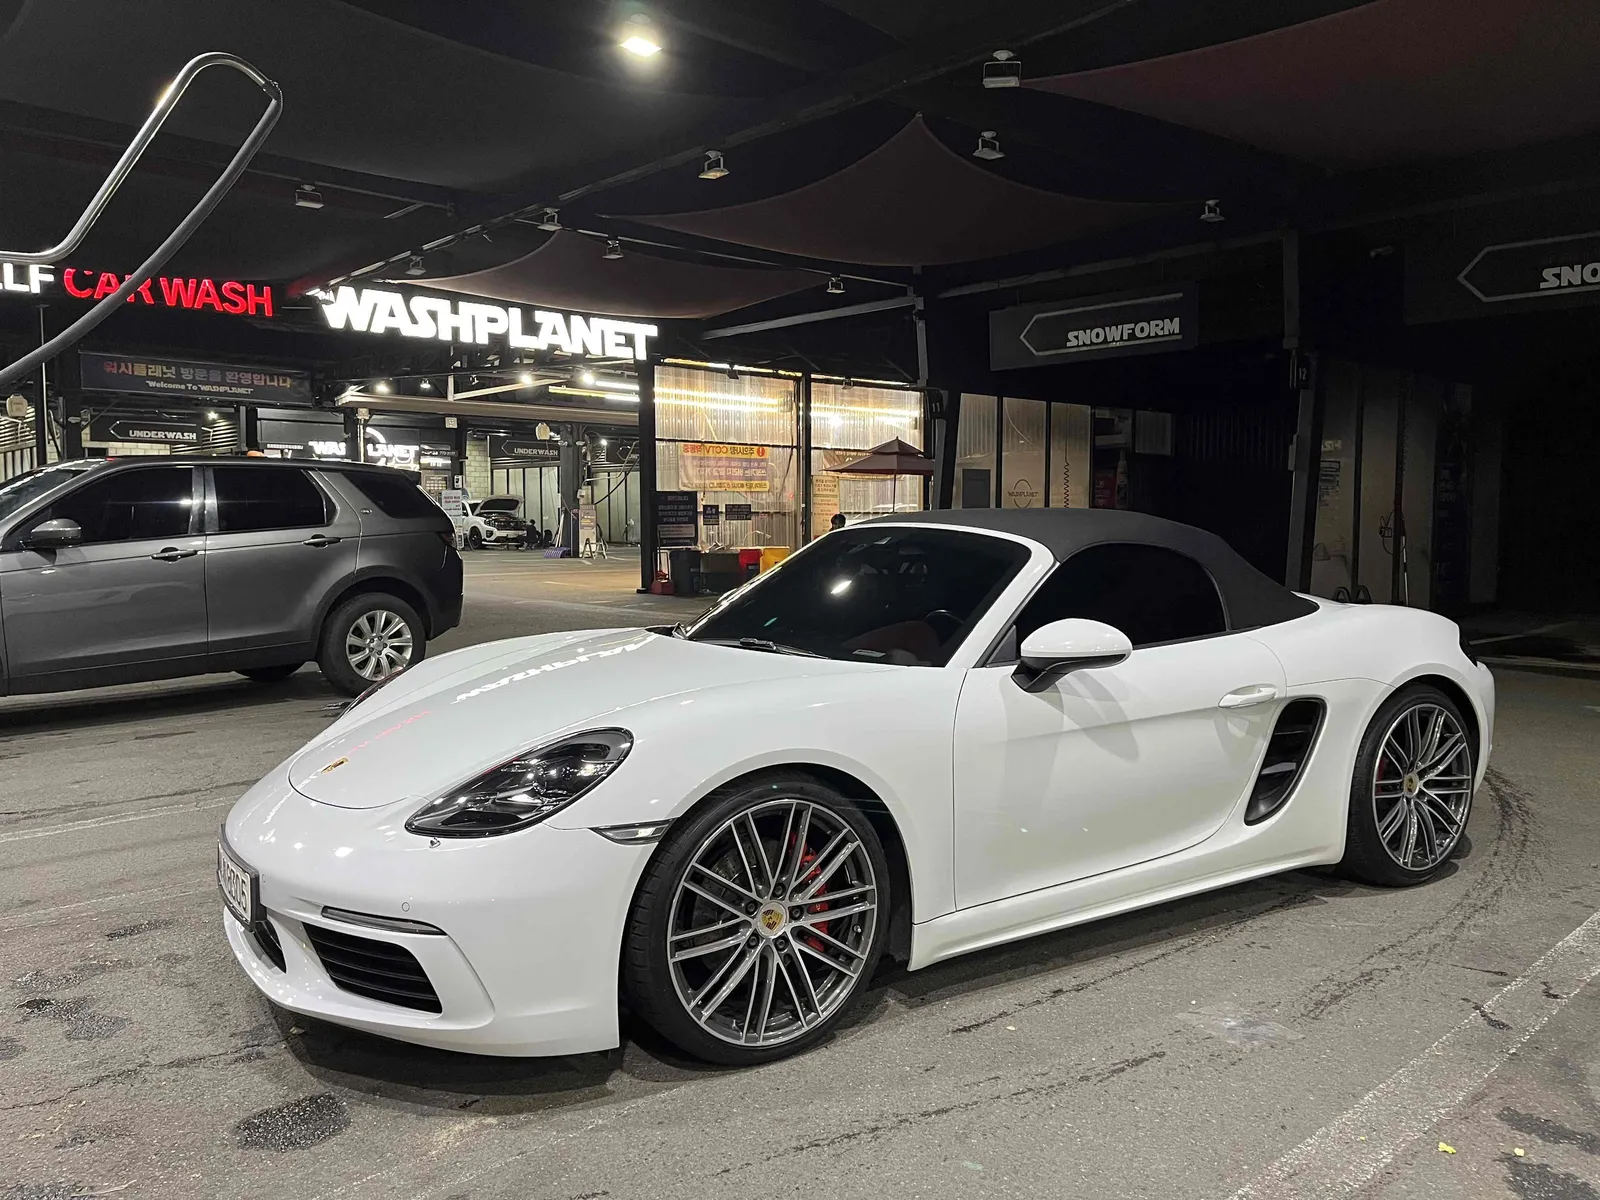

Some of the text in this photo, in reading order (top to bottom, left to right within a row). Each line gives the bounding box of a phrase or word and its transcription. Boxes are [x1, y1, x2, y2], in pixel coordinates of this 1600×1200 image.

[0, 262, 54, 294] LF
[159, 277, 274, 317] WASH
[321, 285, 659, 360] WASHPLANET
[1066, 317, 1180, 347] SNOWFORM
[146, 380, 254, 395] Welcome To WASHPLANET
[179, 366, 222, 383] 방문을
[225, 370, 292, 388] 환영합니다
[128, 429, 197, 440] UNDERWASH
[514, 447, 559, 456] UNDERWASH
